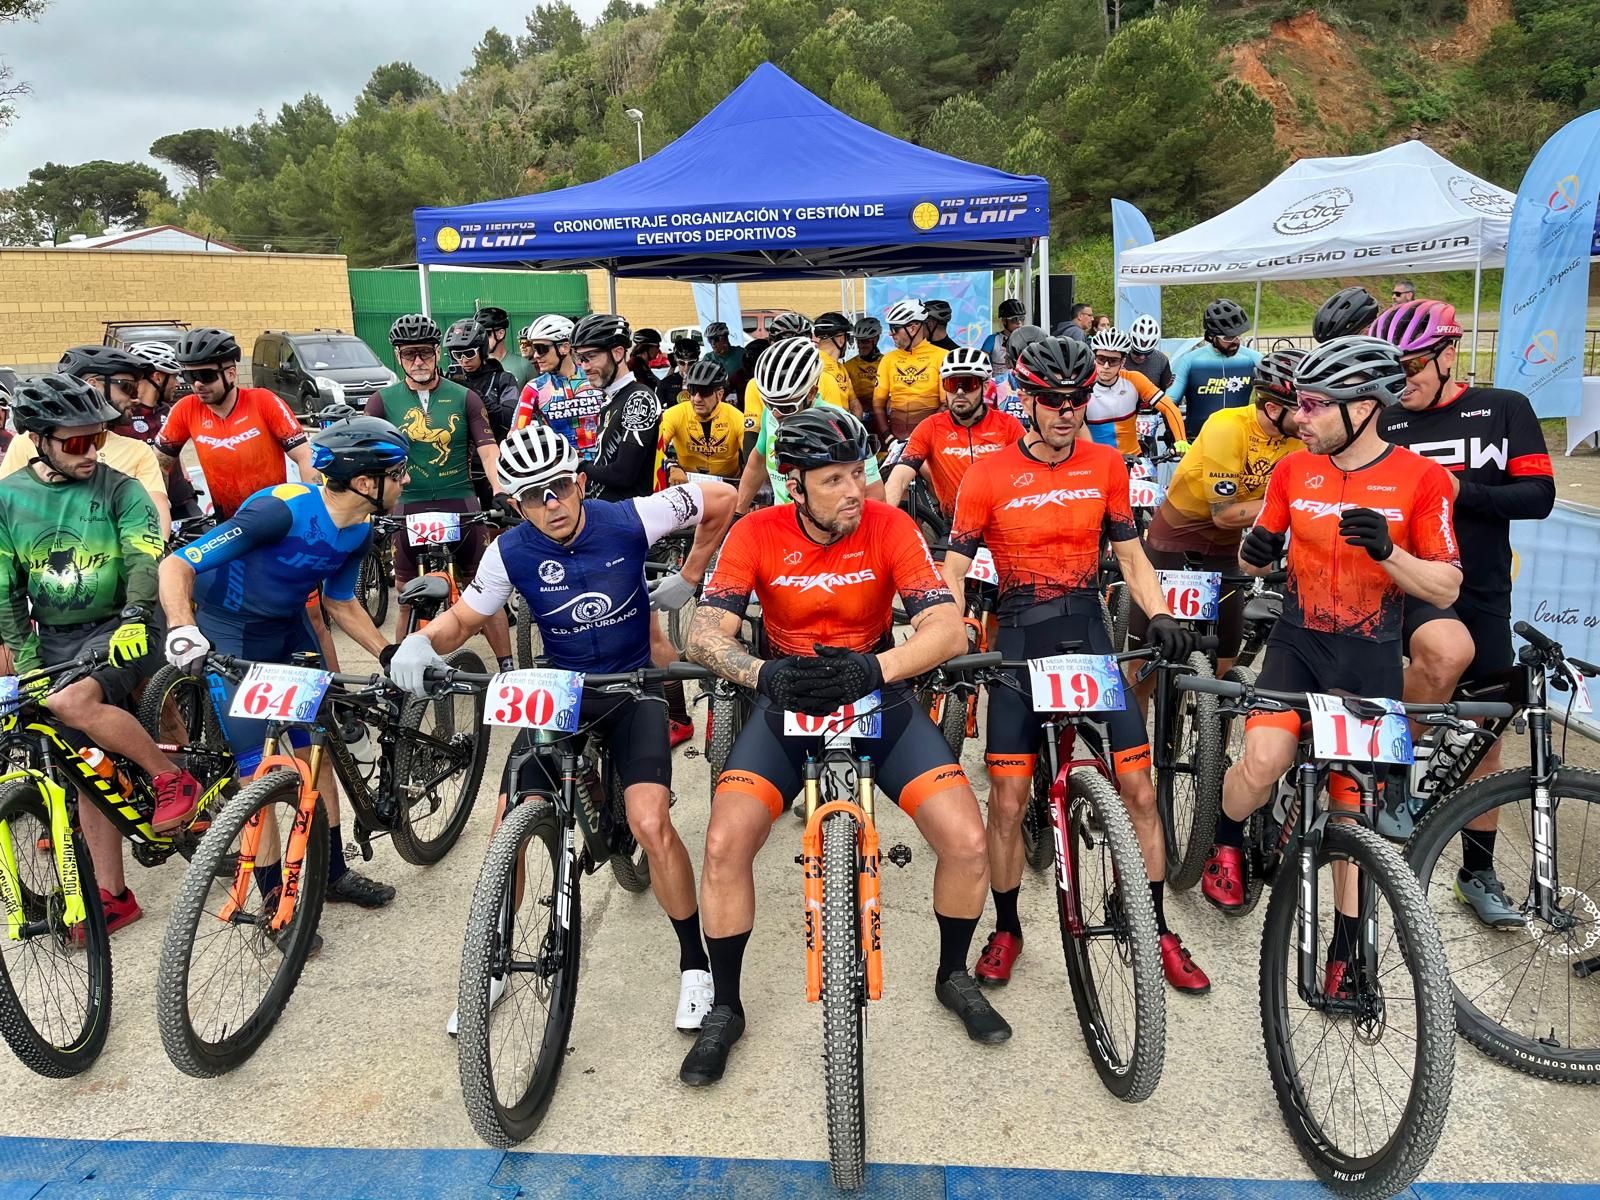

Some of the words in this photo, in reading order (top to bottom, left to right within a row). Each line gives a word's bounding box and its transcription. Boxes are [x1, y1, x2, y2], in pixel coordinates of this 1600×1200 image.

[553, 215, 668, 233] CRONOMETRAJE
[671, 207, 779, 226] ORGANIZACIÓN
[782, 208, 793, 221] Y
[796, 203, 860, 220] GESTIÓN
[864, 203, 884, 217] DE
[637, 230, 702, 245] EVENTOS
[705, 227, 797, 242] DEPORTIVOS
[1226, 262, 1251, 270] DE
[1256, 251, 1346, 268] CICLISMO
[1353, 246, 1382, 259] DE
[1391, 236, 1471, 255] CEUTA
[1197, 385, 1226, 395] CHIC
[548, 406, 601, 420] FRATRES
[1461, 408, 1492, 418] NOW
[1400, 437, 1509, 470] OW
[1003, 488, 1102, 511] AFRIKANOS
[200, 526, 243, 554] aesco
[412, 521, 446, 544] 29
[770, 568, 877, 595] AFRIKANOS
[551, 627, 572, 635] C.D.
[573, 622, 594, 633] SAN
[594, 608, 638, 628] URBANO
[243, 682, 299, 717] 64
[1046, 673, 1099, 709] 19
[495, 686, 555, 726] 30
[1329, 714, 1384, 759] 17
[63, 843, 78, 896] ROCKSHOX
[285, 870, 300, 898] FOX
[1514, 1048, 1567, 1069] CONTROL
[1333, 1169, 1350, 1181] TRAK
[1350, 1171, 1367, 1181] FAST
